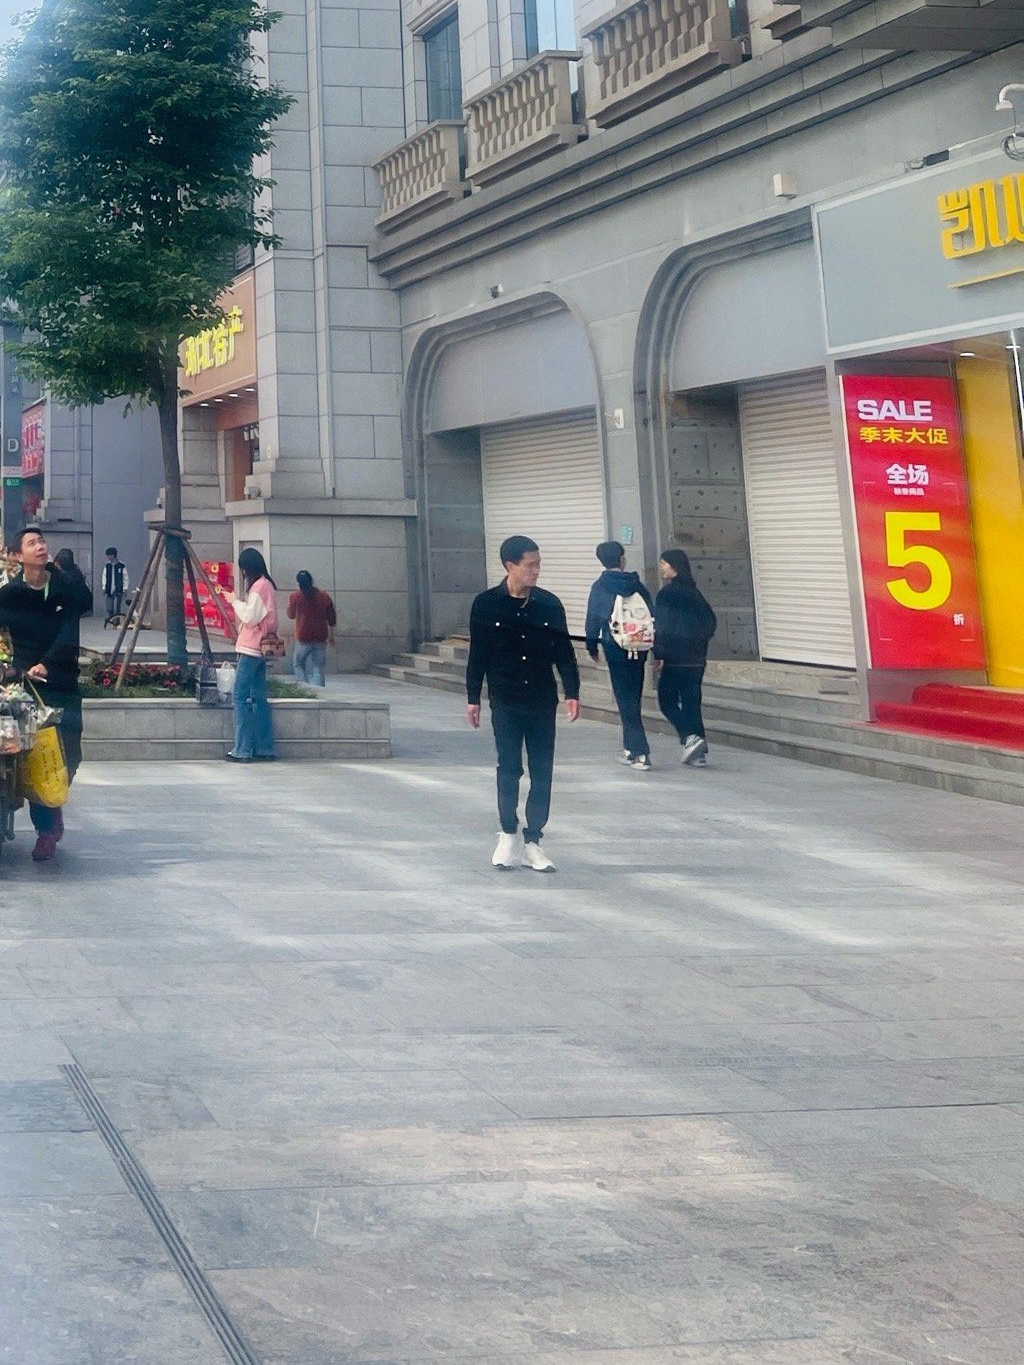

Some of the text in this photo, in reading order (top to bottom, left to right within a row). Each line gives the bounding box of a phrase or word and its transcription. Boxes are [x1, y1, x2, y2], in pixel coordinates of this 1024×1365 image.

[857, 399, 933, 422] SALE
[7, 438, 20, 453] D
[860, 427, 949, 445] 季末大促
[886, 463, 930, 486] 全场
[884, 511, 952, 610] 5
[953, 613, 965, 626] 折
